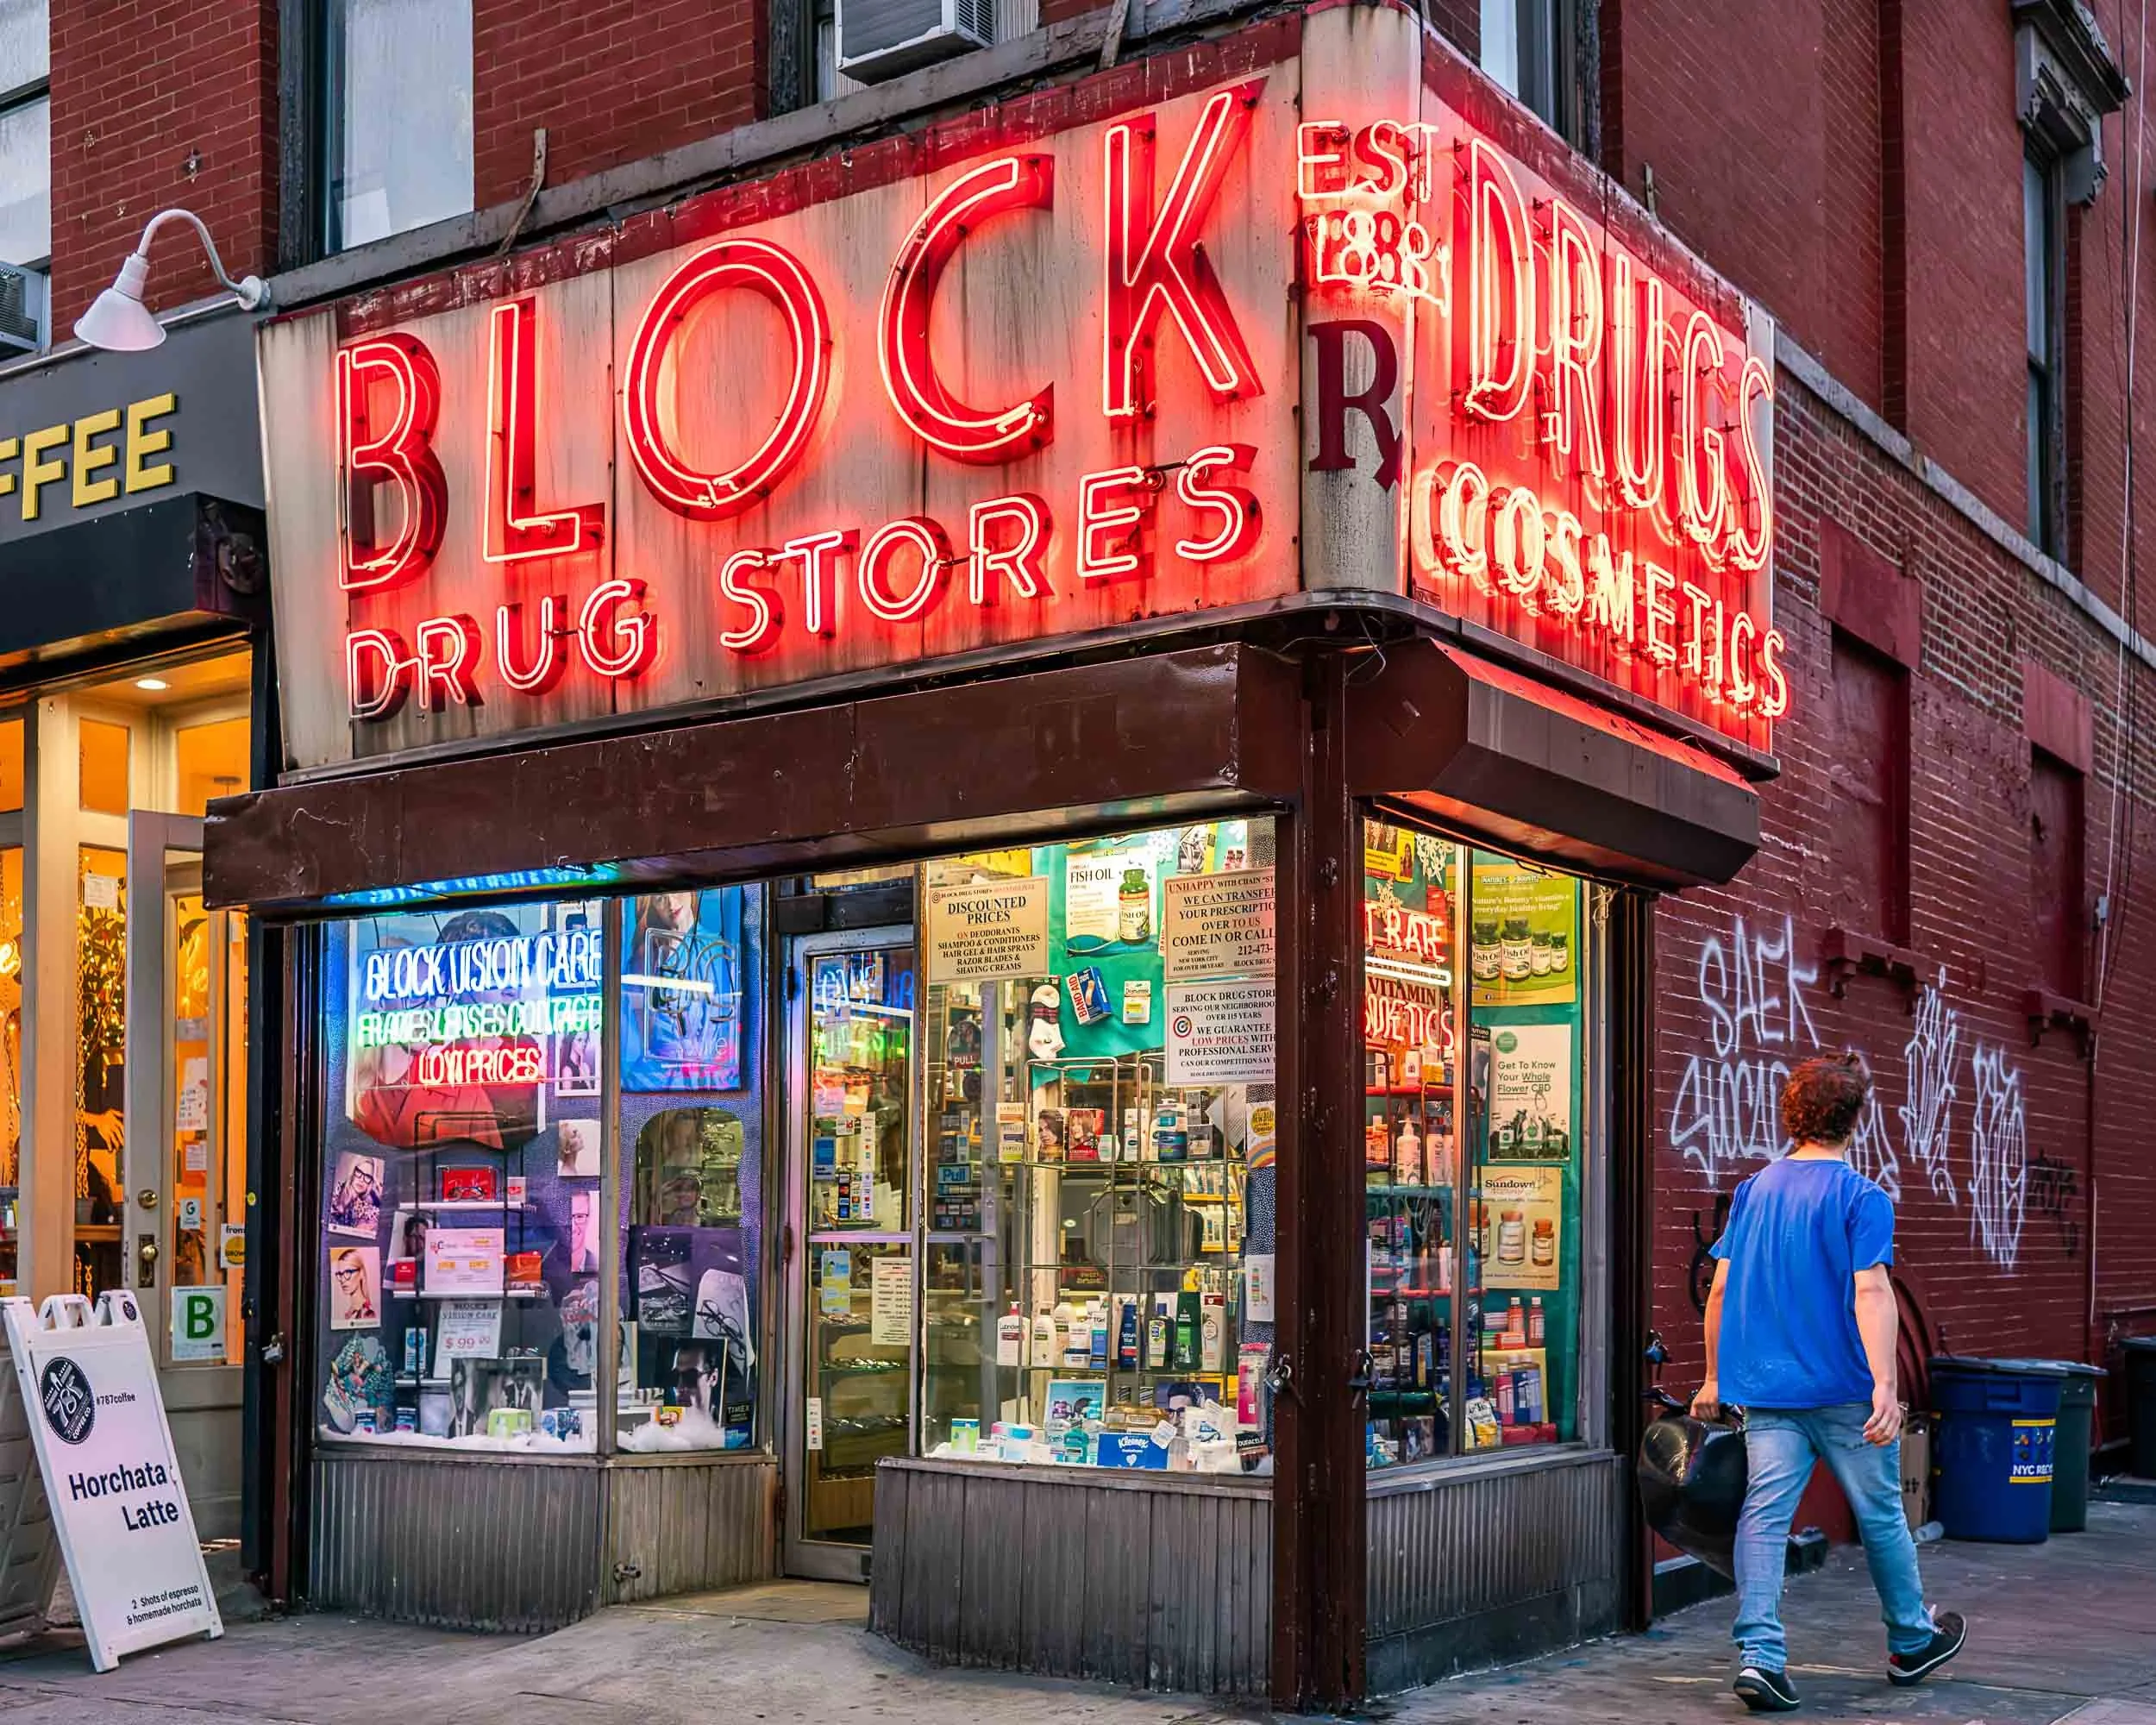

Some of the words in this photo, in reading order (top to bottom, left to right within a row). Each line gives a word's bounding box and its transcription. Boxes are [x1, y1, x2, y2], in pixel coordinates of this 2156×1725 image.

[1298, 119, 1438, 204] EST
[335, 78, 1269, 595] BLOCK
[1459, 136, 1773, 573] DRUGS
[347, 578, 657, 721] DRUG
[719, 443, 1263, 656] STORES
[1421, 460, 1789, 718] COSMETICS
[1070, 870, 1093, 883] FISH
[1095, 868, 1114, 880] OIL
[1169, 880, 1215, 894] UNHAPPY
[1238, 876, 1260, 886] CHAIN
[948, 896, 1026, 914] DISCOUNTED
[1184, 895, 1200, 905] WE
[1202, 894, 1223, 903] CAN
[968, 910, 1010, 925] PRICES
[1180, 909, 1207, 919] YOUR
[1201, 921, 1229, 931] OVER
[1232, 919, 1245, 928] TO
[1249, 917, 1261, 926] US
[970, 926, 1020, 938] DEODORANTS
[1172, 934, 1206, 947] COME
[1210, 933, 1221, 944] IN
[1225, 931, 1242, 943] OR
[937, 940, 975, 950] SHAMPOO
[984, 933, 1041, 945] CONDITIONERS
[943, 949, 962, 958] HAIR
[963, 948, 978, 957] GEL
[987, 945, 1006, 954] HAIR
[1006, 944, 1035, 953] SPRAYS
[366, 945, 446, 1000] BLOCK
[448, 936, 531, 994] VISION
[535, 931, 602, 988] CARE
[957, 957, 982, 966] RAZOR
[984, 954, 1013, 964] BLADES
[956, 965, 988, 975] SHAVING
[990, 963, 1021, 972] CREAMS
[1069, 975, 1087, 1018] BAND-AID
[1185, 993, 1217, 1002] BLOCK
[1219, 991, 1245, 1000] DRUG
[1206, 1013, 1225, 1021] OVER
[1238, 1011, 1262, 1019] YEARS
[1197, 1026, 1212, 1035] WE
[1214, 1023, 1271, 1034] GUARANTEE
[1192, 1037, 1213, 1046] LOW
[1216, 1035, 1249, 1044] PRICES
[1179, 1045, 1248, 1057] PROFESSIONAL
[466, 1047, 541, 1084] PRICES
[953, 1055, 975, 1065] PULL
[1522, 1072, 1551, 1081] Whole
[1497, 1084, 1528, 1093] Flower
[1531, 1083, 1551, 1092] CBD
[942, 1167, 967, 1182] Pull
[186, 1295, 215, 1339] B
[445, 1338, 454, 1349] $
[457, 1338, 474, 1349] 99
[97, 1393, 136, 1405] #787coffee
[1118, 1436, 1150, 1449] Kleenex
[2013, 1465, 2034, 1476] NYC
[68, 1462, 167, 1501] Horchata
[122, 1500, 179, 1531] Latte
[132, 1599, 138, 1609] 2
[141, 1595, 160, 1607] Shots
[161, 1590, 167, 1603] of
[168, 1584, 199, 1600] espresso
[134, 1606, 172, 1625] homemade
[172, 1597, 202, 1615] horchata
